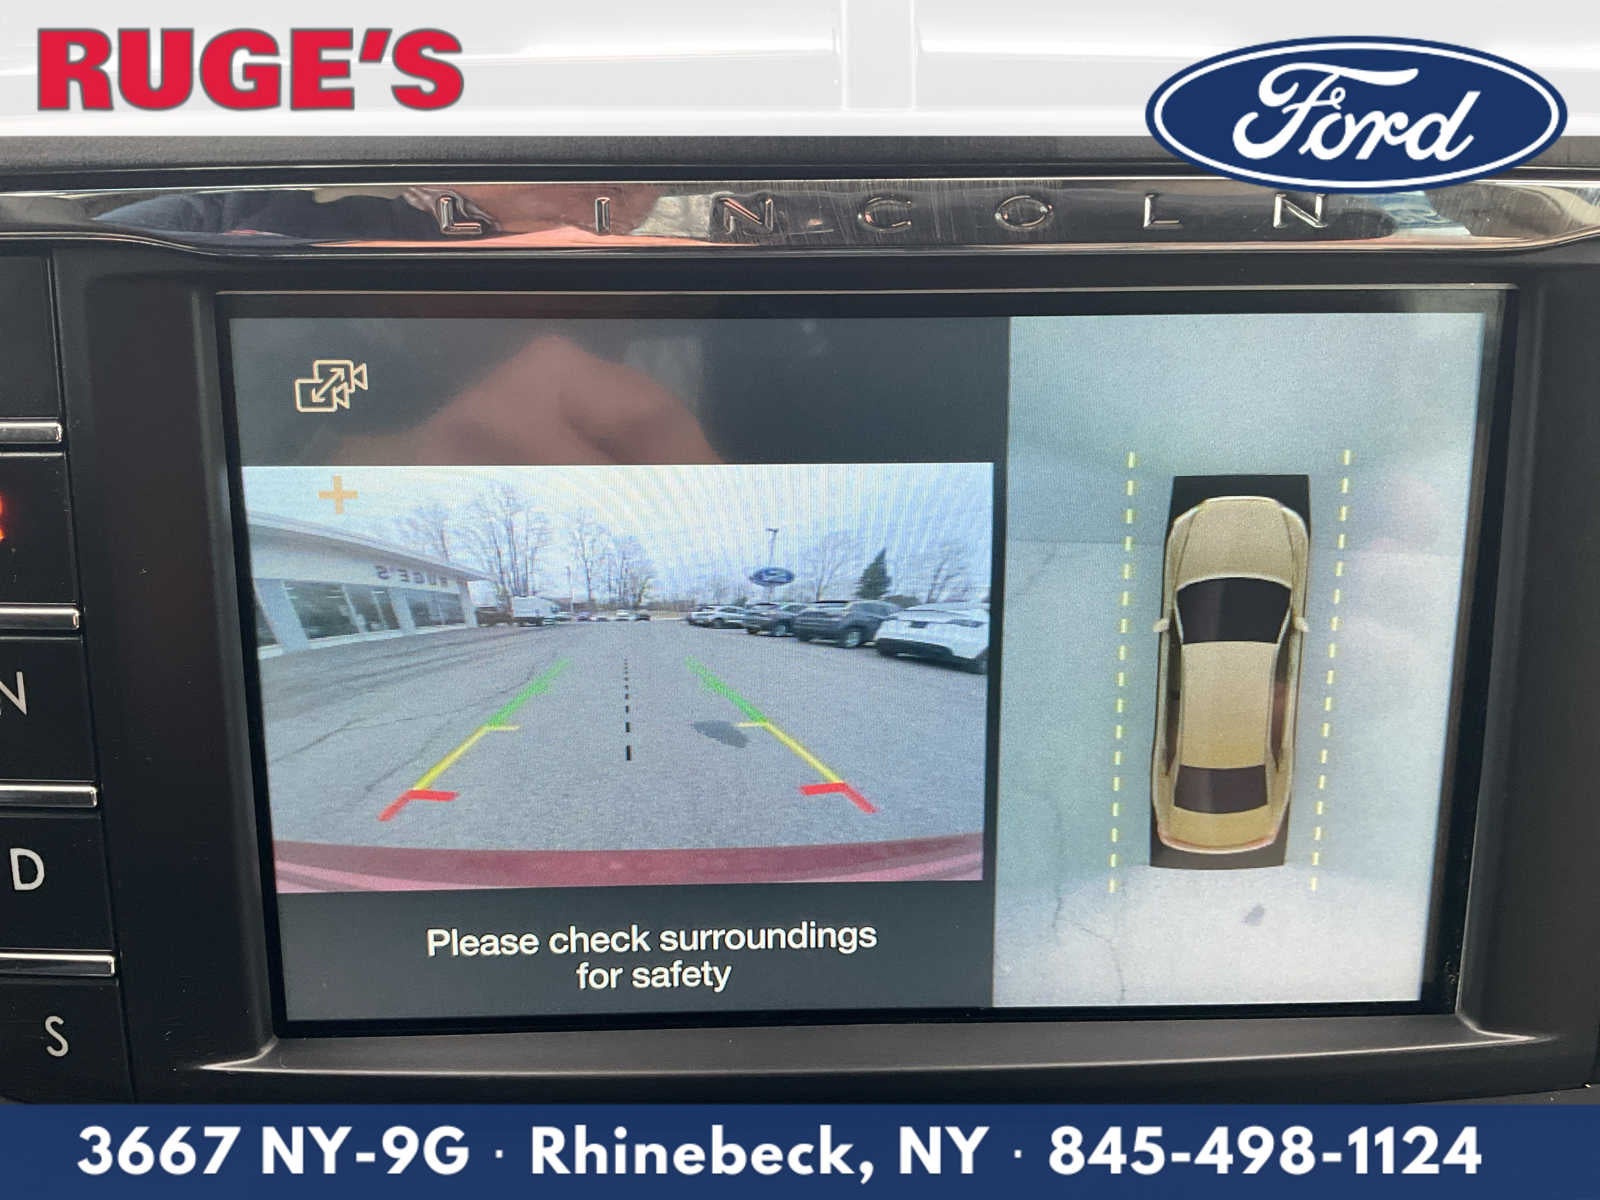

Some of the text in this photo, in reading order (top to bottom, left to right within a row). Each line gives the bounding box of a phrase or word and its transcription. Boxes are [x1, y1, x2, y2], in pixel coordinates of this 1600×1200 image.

[437, 193, 1328, 236] LINCOLN
[9, 847, 45, 891] D
[426, 920, 878, 957] Please check surroundings
[575, 959, 732, 993] for safety
[44, 1015, 70, 1058] S
